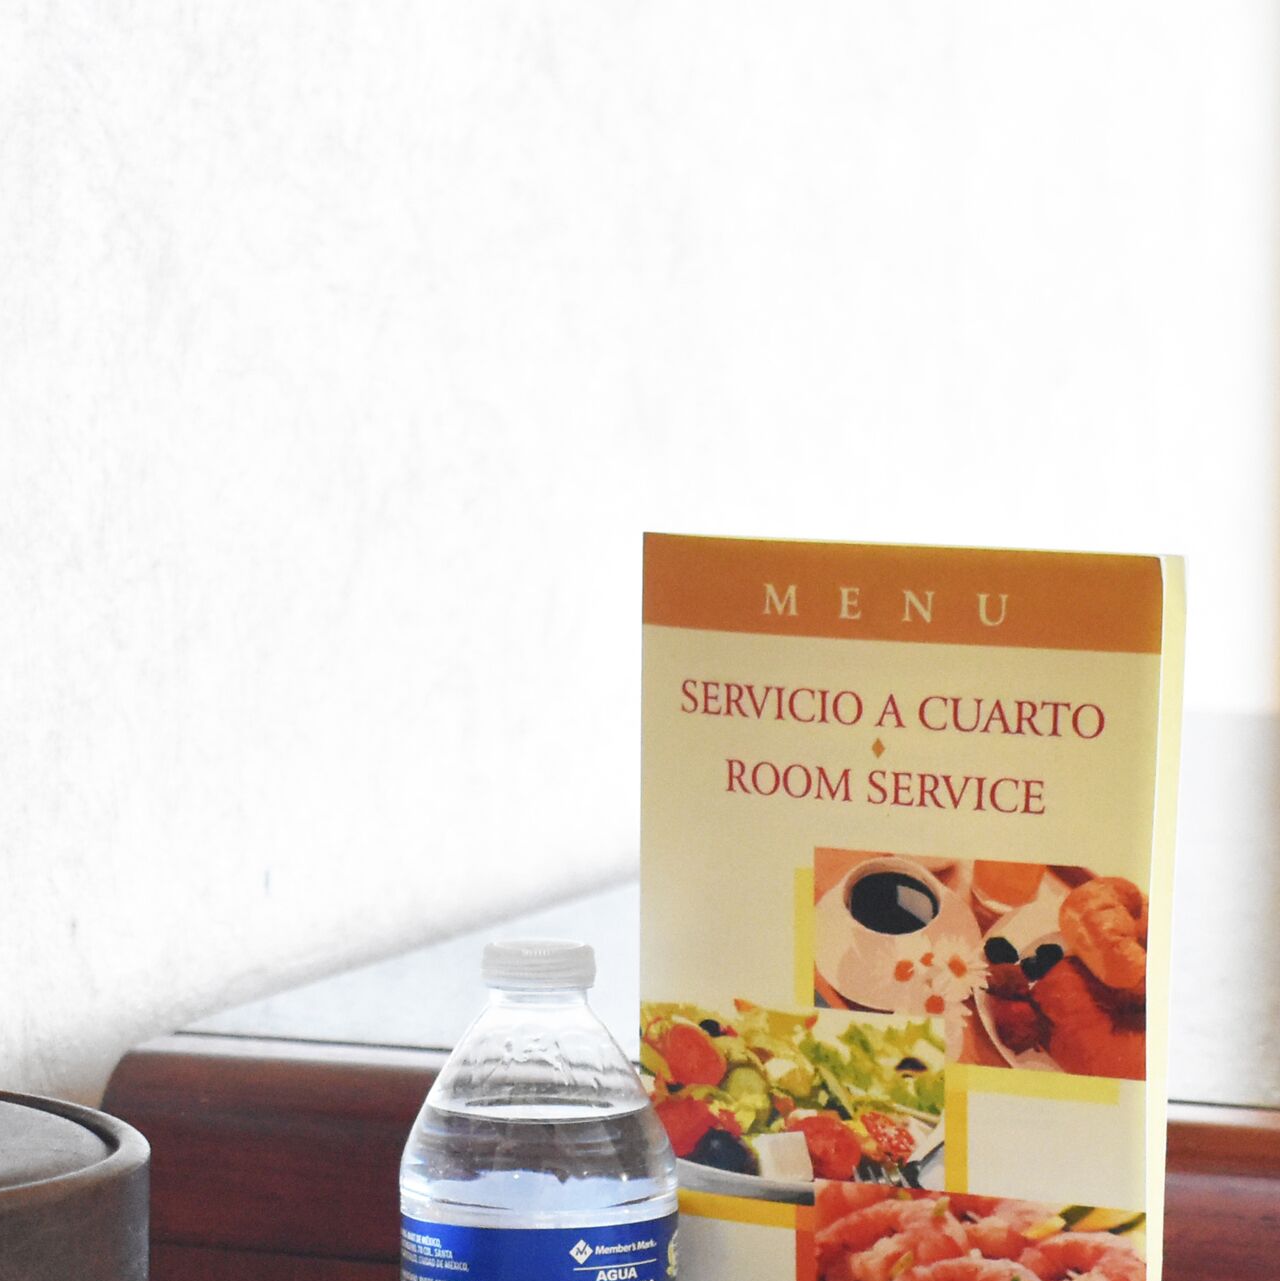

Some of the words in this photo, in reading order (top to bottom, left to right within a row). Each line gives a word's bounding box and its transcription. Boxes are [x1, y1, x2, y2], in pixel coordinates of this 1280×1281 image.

[763, 583, 1008, 627] MENU
[680, 680, 863, 726] SERVICIO
[876, 693, 907, 729] A
[919, 696, 1106, 740] CUARTO
[725, 758, 853, 802] ROOM
[867, 770, 1046, 815] SERVICE
[595, 1244, 636, 1256] Member's
[596, 1267, 638, 1281] AGUA
